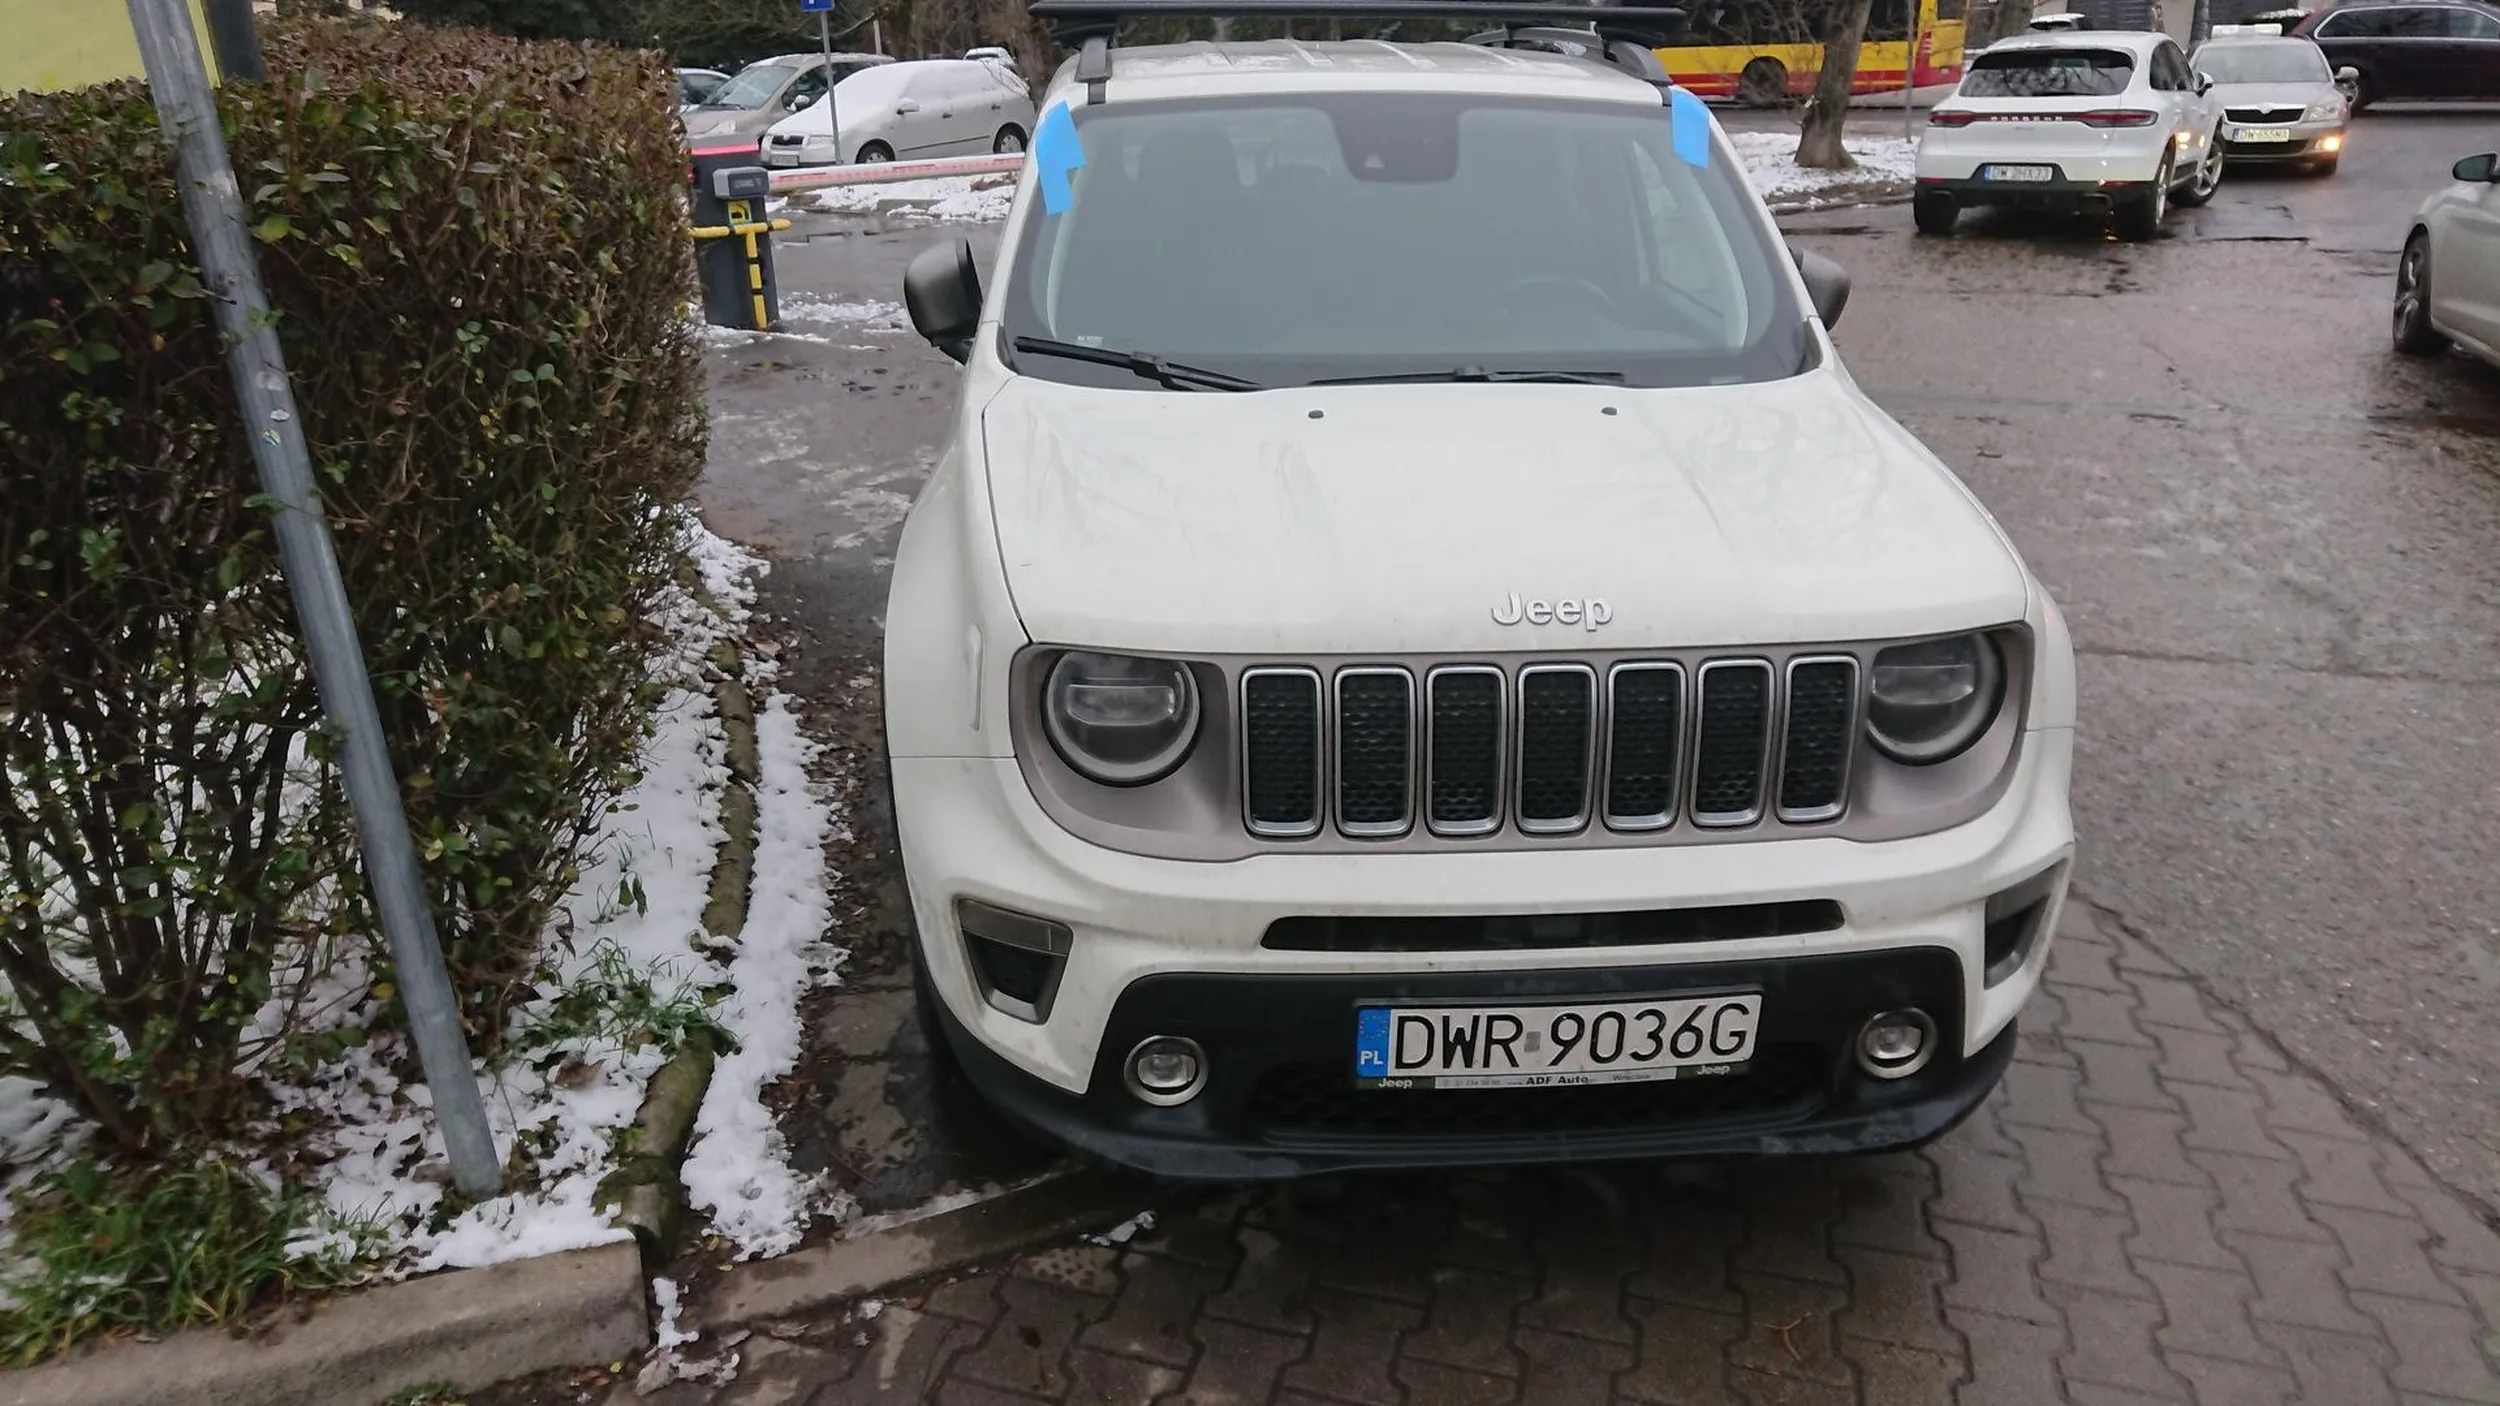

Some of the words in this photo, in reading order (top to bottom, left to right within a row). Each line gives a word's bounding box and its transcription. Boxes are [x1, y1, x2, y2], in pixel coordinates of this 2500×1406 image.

[1491, 592, 1613, 632] Jeep
[1395, 1014, 1523, 1069] DWR
[1548, 1003, 1750, 1067] 9036G
[1360, 1050, 1384, 1065] PL
[1697, 1065, 1730, 1076] Jeep
[1378, 1077, 1413, 1089] Jeep
[1526, 1076, 1552, 1085] ADF
[1557, 1075, 1588, 1084] Auto
